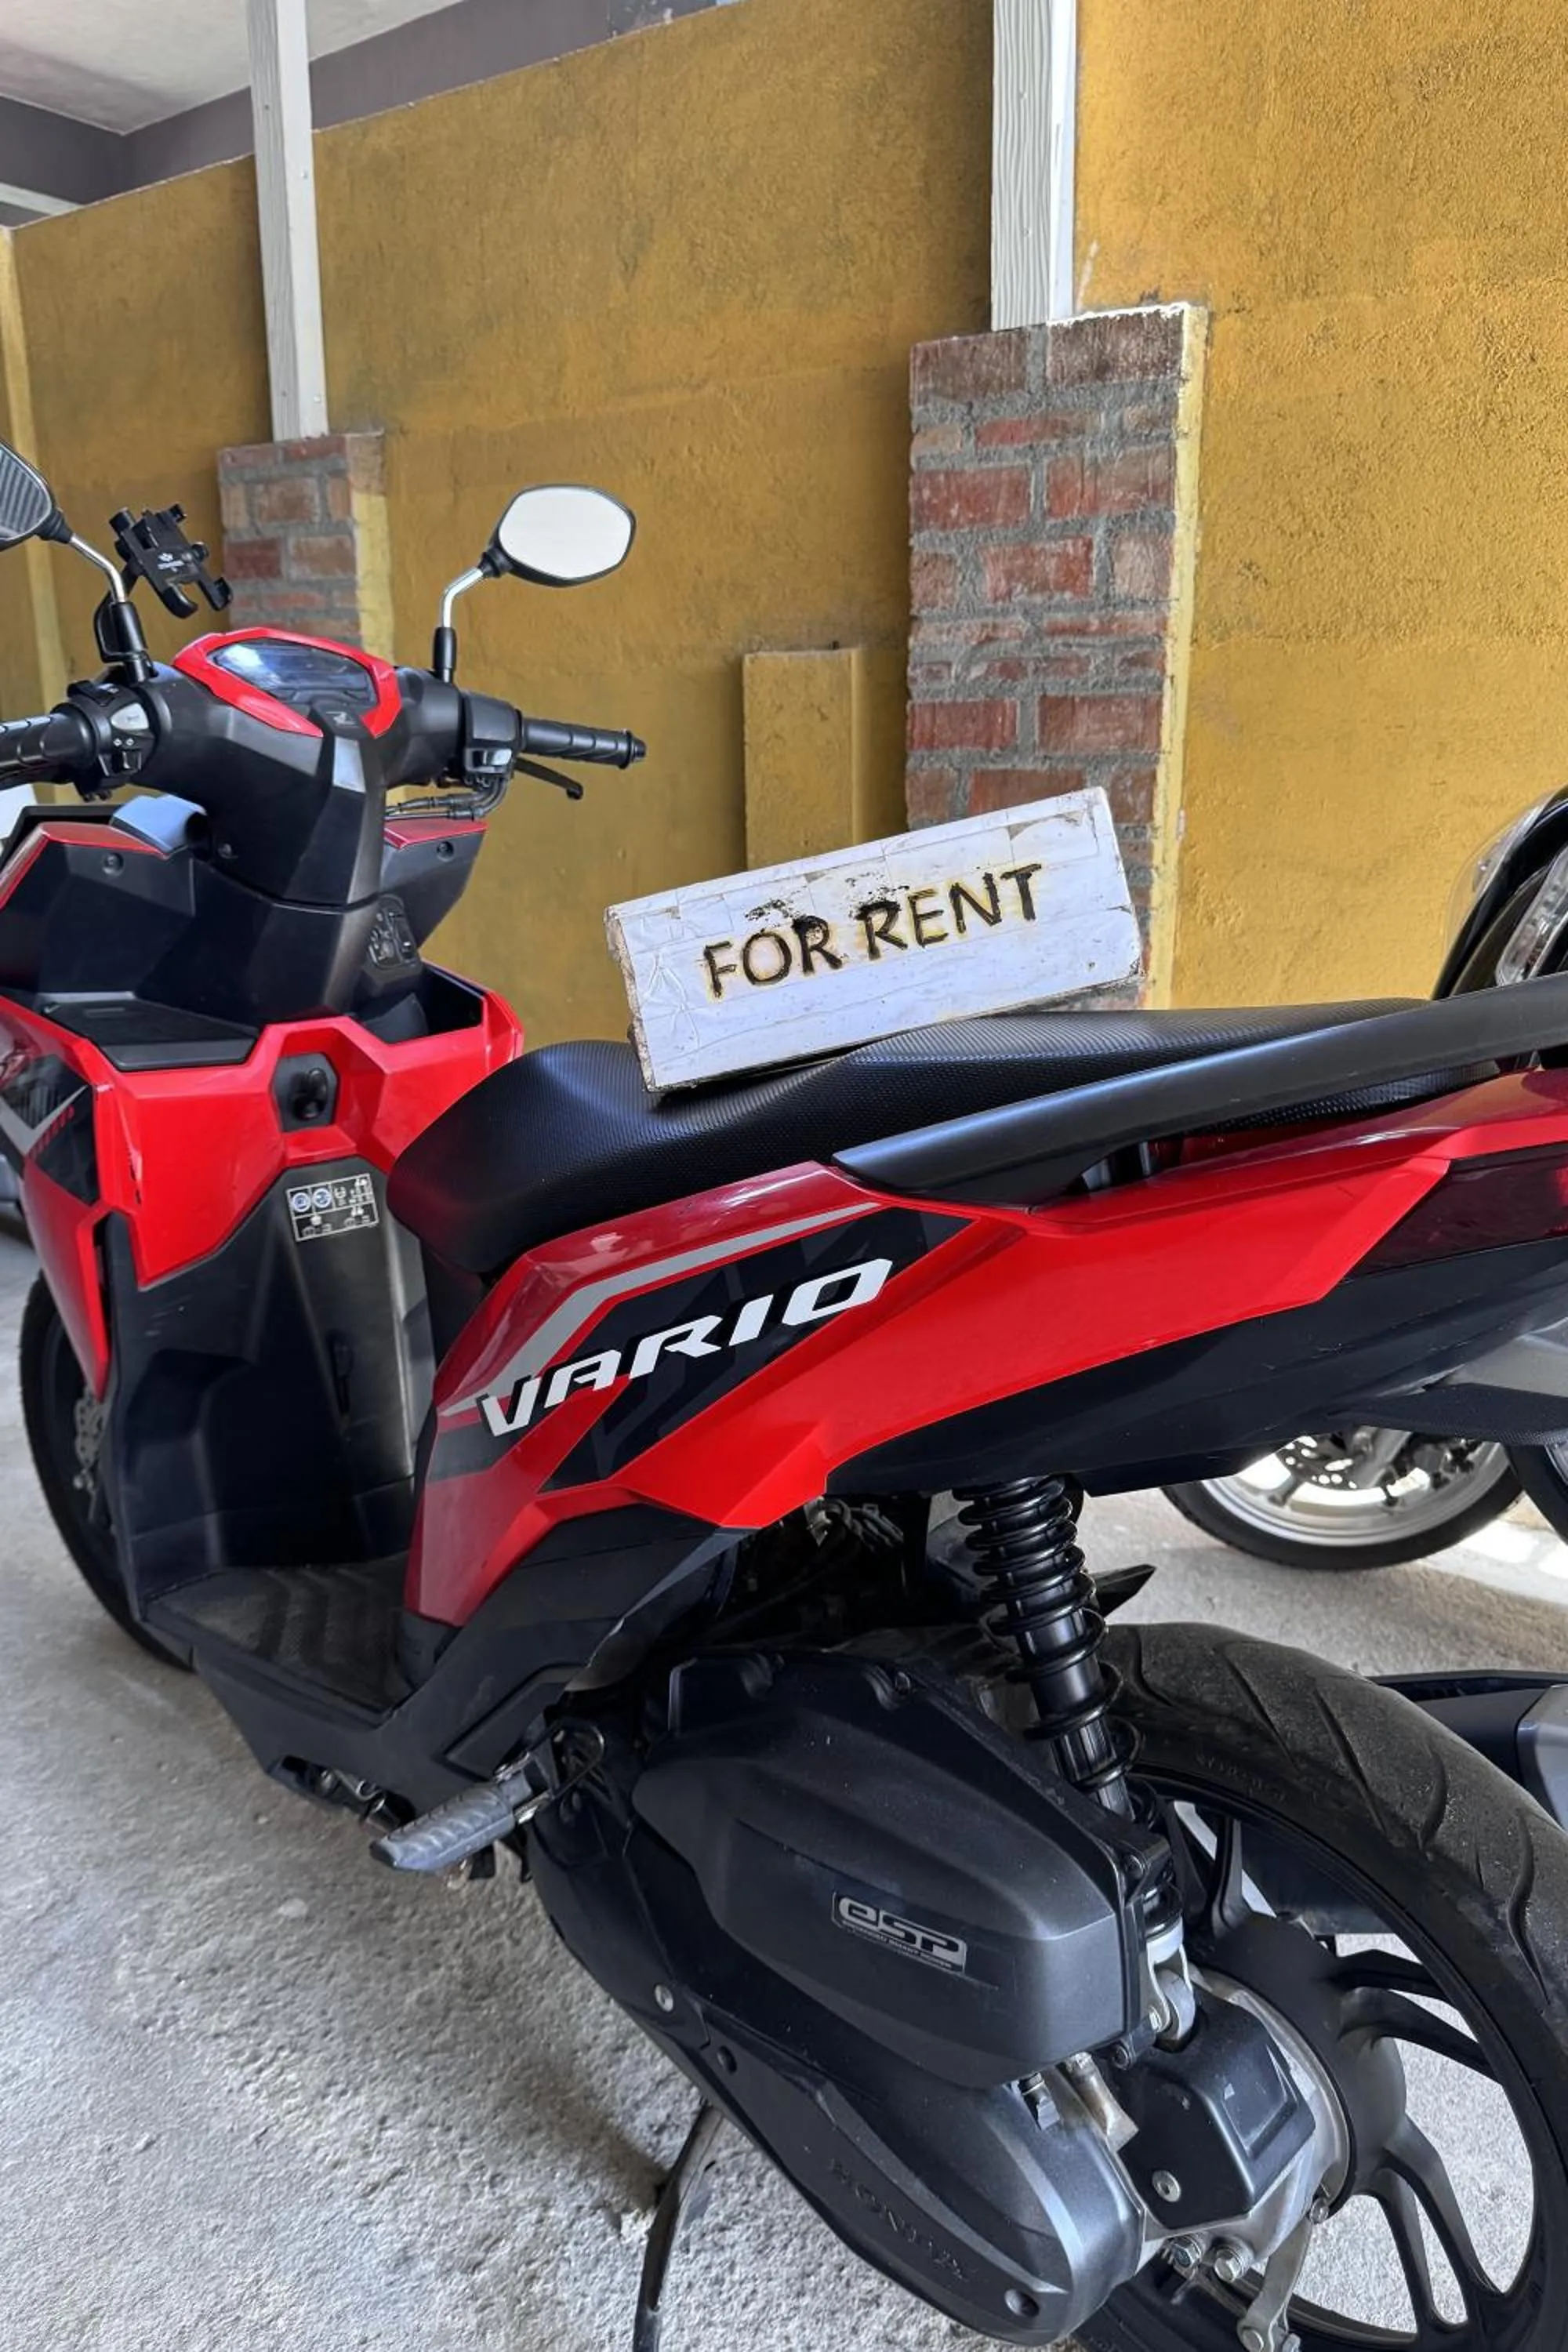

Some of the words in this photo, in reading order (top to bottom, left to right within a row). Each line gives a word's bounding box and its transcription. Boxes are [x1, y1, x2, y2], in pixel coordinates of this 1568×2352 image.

[703, 914, 843, 998] FOR
[856, 864, 1041, 960] RENT
[477, 1258, 893, 1437] VARIO
